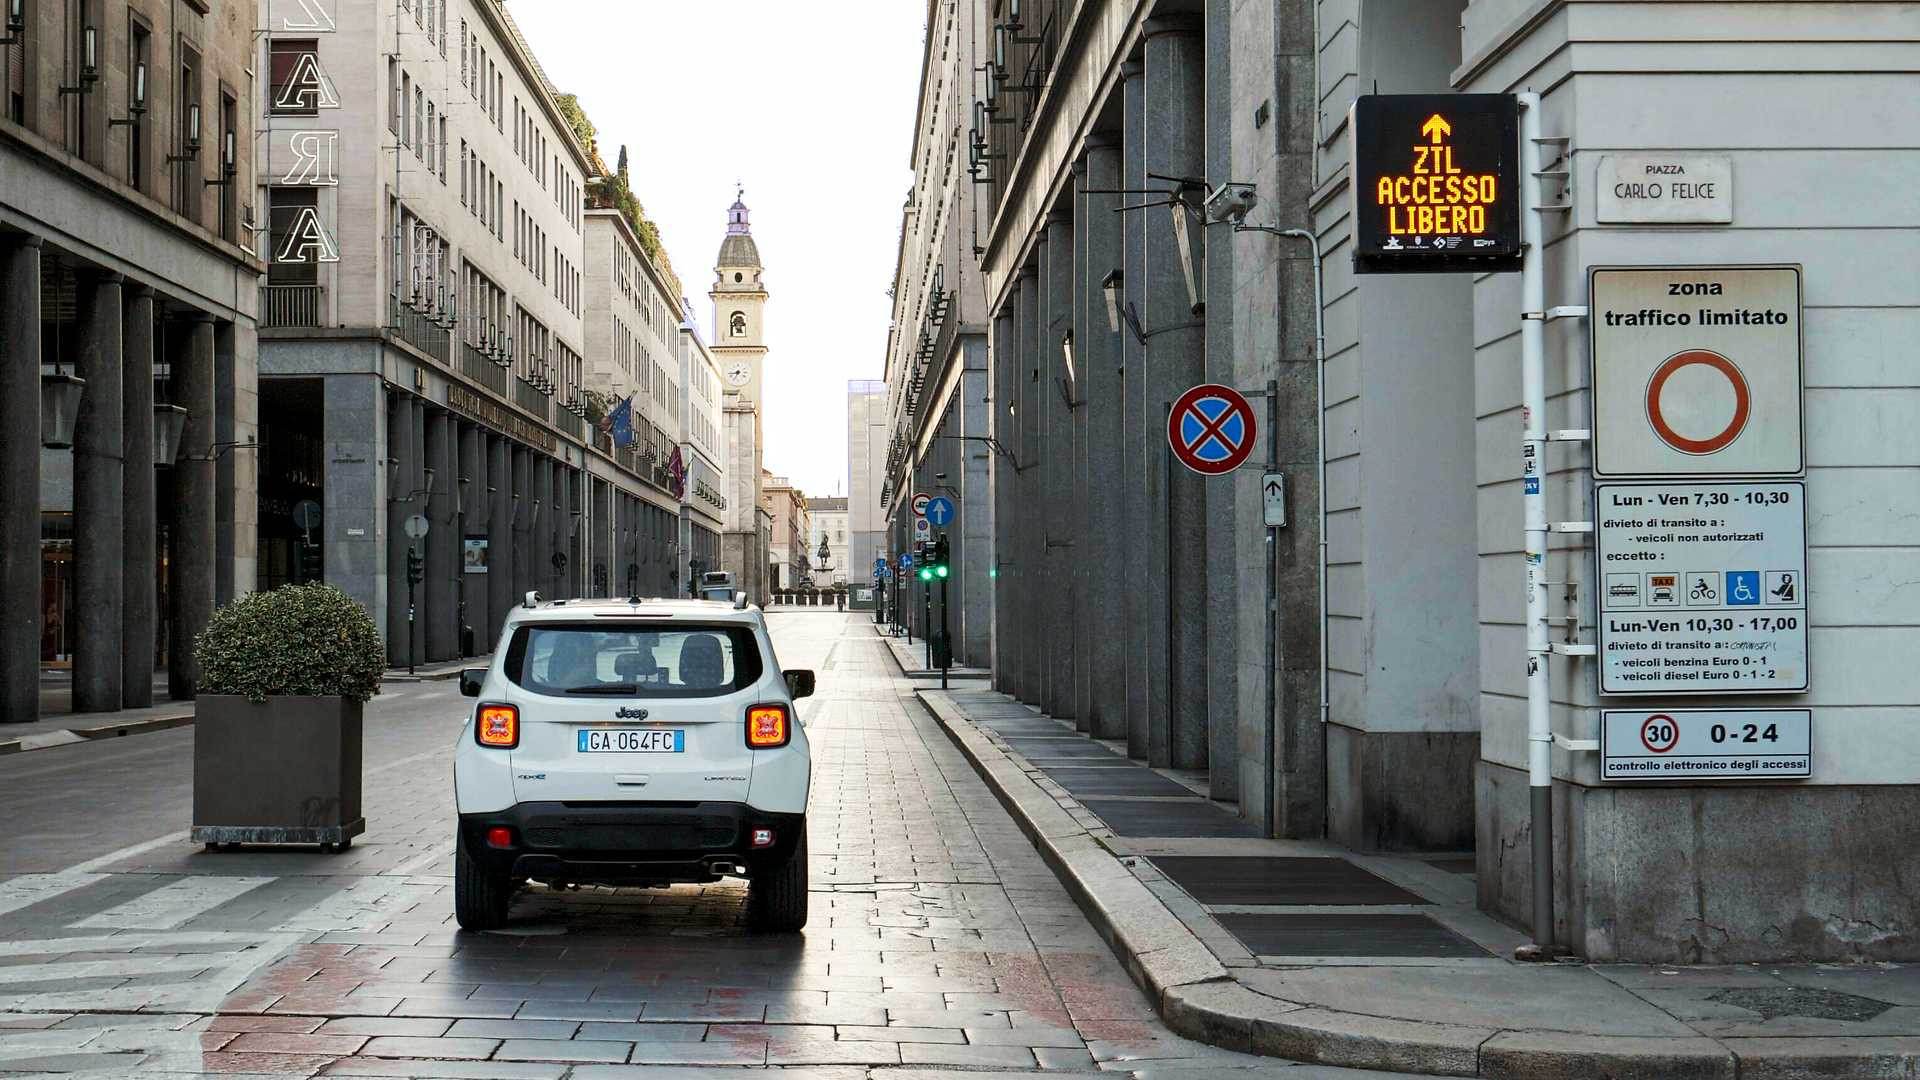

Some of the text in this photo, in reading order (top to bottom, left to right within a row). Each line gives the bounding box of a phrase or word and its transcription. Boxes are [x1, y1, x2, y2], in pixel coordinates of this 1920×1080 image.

[1413, 145, 1462, 175] ZTL
[1645, 165, 1685, 175] PIAZZA
[1377, 175, 1496, 205] ACCESSO
[1614, 182, 1715, 199] CARLO FELICE
[1389, 205, 1485, 235] LIBERO
[1668, 282, 1723, 296] zona
[1604, 308, 1788, 327] traffico limitato
[1612, 494, 1643, 507] Lun
[1657, 493, 1689, 506] Ven
[1693, 492, 1729, 508] 7,30
[1744, 491, 1790, 507] 10,30
[1603, 519, 1644, 529] divieto
[1646, 518, 1658, 528] di
[1661, 517, 1707, 528] transito
[1710, 519, 1718, 527] a
[1635, 533, 1674, 543] veicoli
[1677, 535, 1699, 543] non
[1702, 531, 1764, 542] autorizzati
[1606, 551, 1657, 561] eccetto
[1610, 619, 1680, 633] Lun-Ven
[1686, 618, 1734, 634] 10,30
[1749, 617, 1798, 633] 17,00
[1607, 641, 1648, 651] divieto
[1651, 640, 1662, 650] di
[1665, 640, 1711, 650] transito
[1714, 641, 1722, 649] a
[1622, 657, 1661, 668] veicoli
[1663, 657, 1709, 667] benzina
[1712, 656, 1740, 666] Euro
[1742, 656, 1750, 666] 0
[1760, 655, 1767, 665] 1
[1622, 671, 1661, 681] veicoli
[1664, 670, 1699, 681] diesel
[1702, 670, 1730, 680] Euro
[1732, 670, 1740, 680] 0
[1750, 669, 1757, 680] 1
[1767, 669, 1776, 679] 2
[615, 706, 649, 720] Jeep
[1646, 724, 1673, 743] 30
[1608, 759, 1807, 772] controllo elettronico degli accessi
